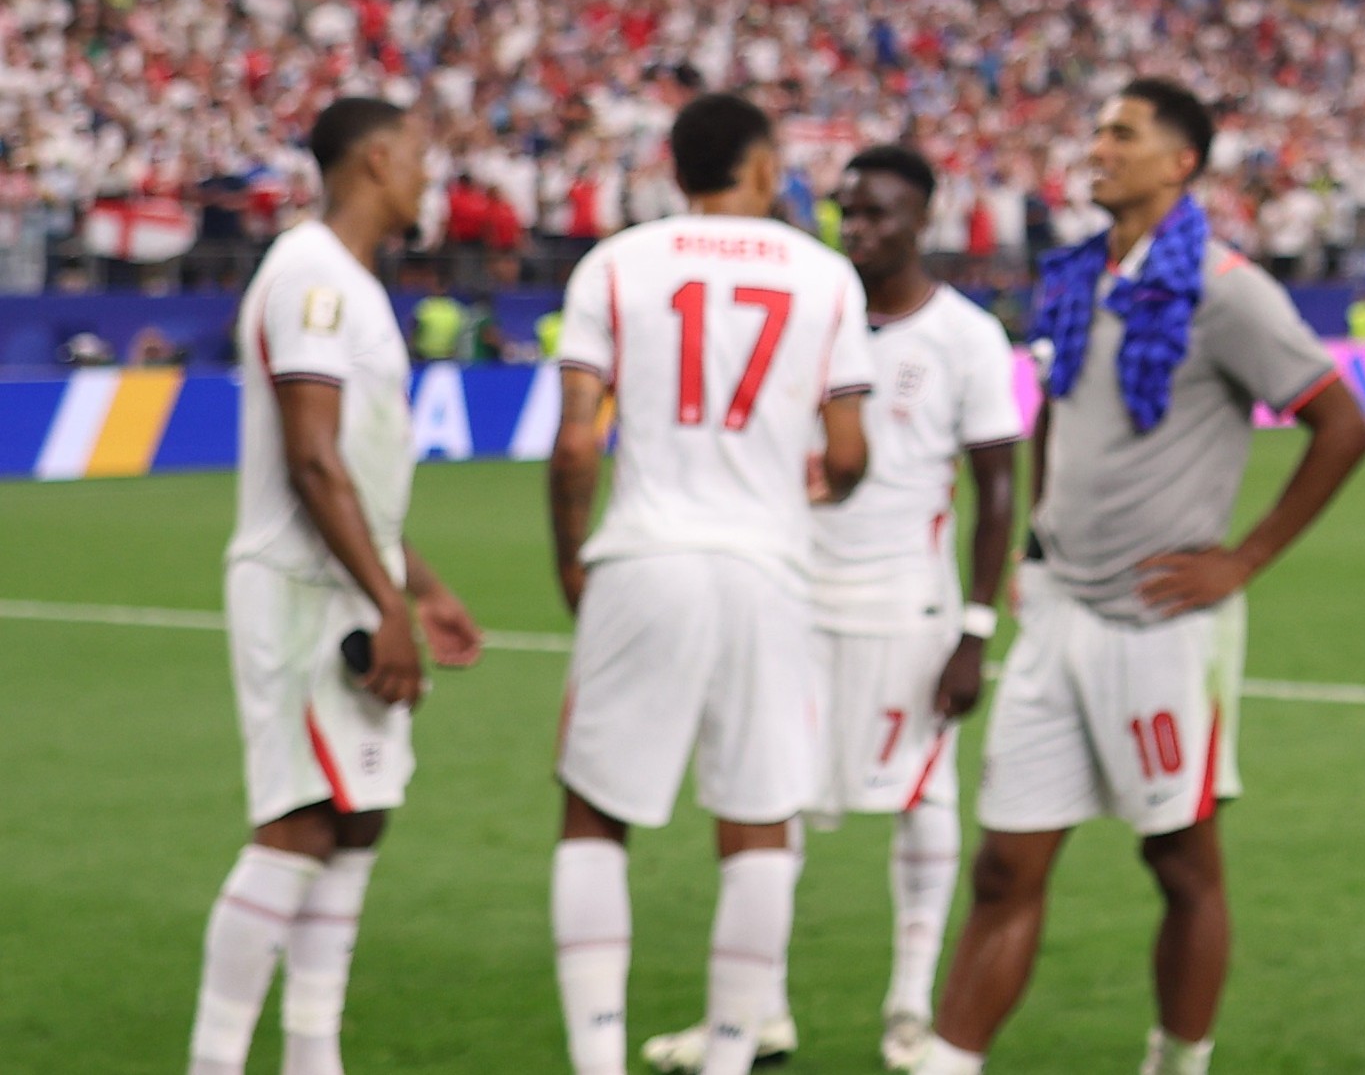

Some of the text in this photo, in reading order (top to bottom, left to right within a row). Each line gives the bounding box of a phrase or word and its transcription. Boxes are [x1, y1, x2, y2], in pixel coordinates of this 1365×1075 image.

[672, 234, 790, 264] ROGERS
[671, 280, 793, 431] 17
[884, 709, 906, 766] 7
[1130, 711, 1184, 781] 10
